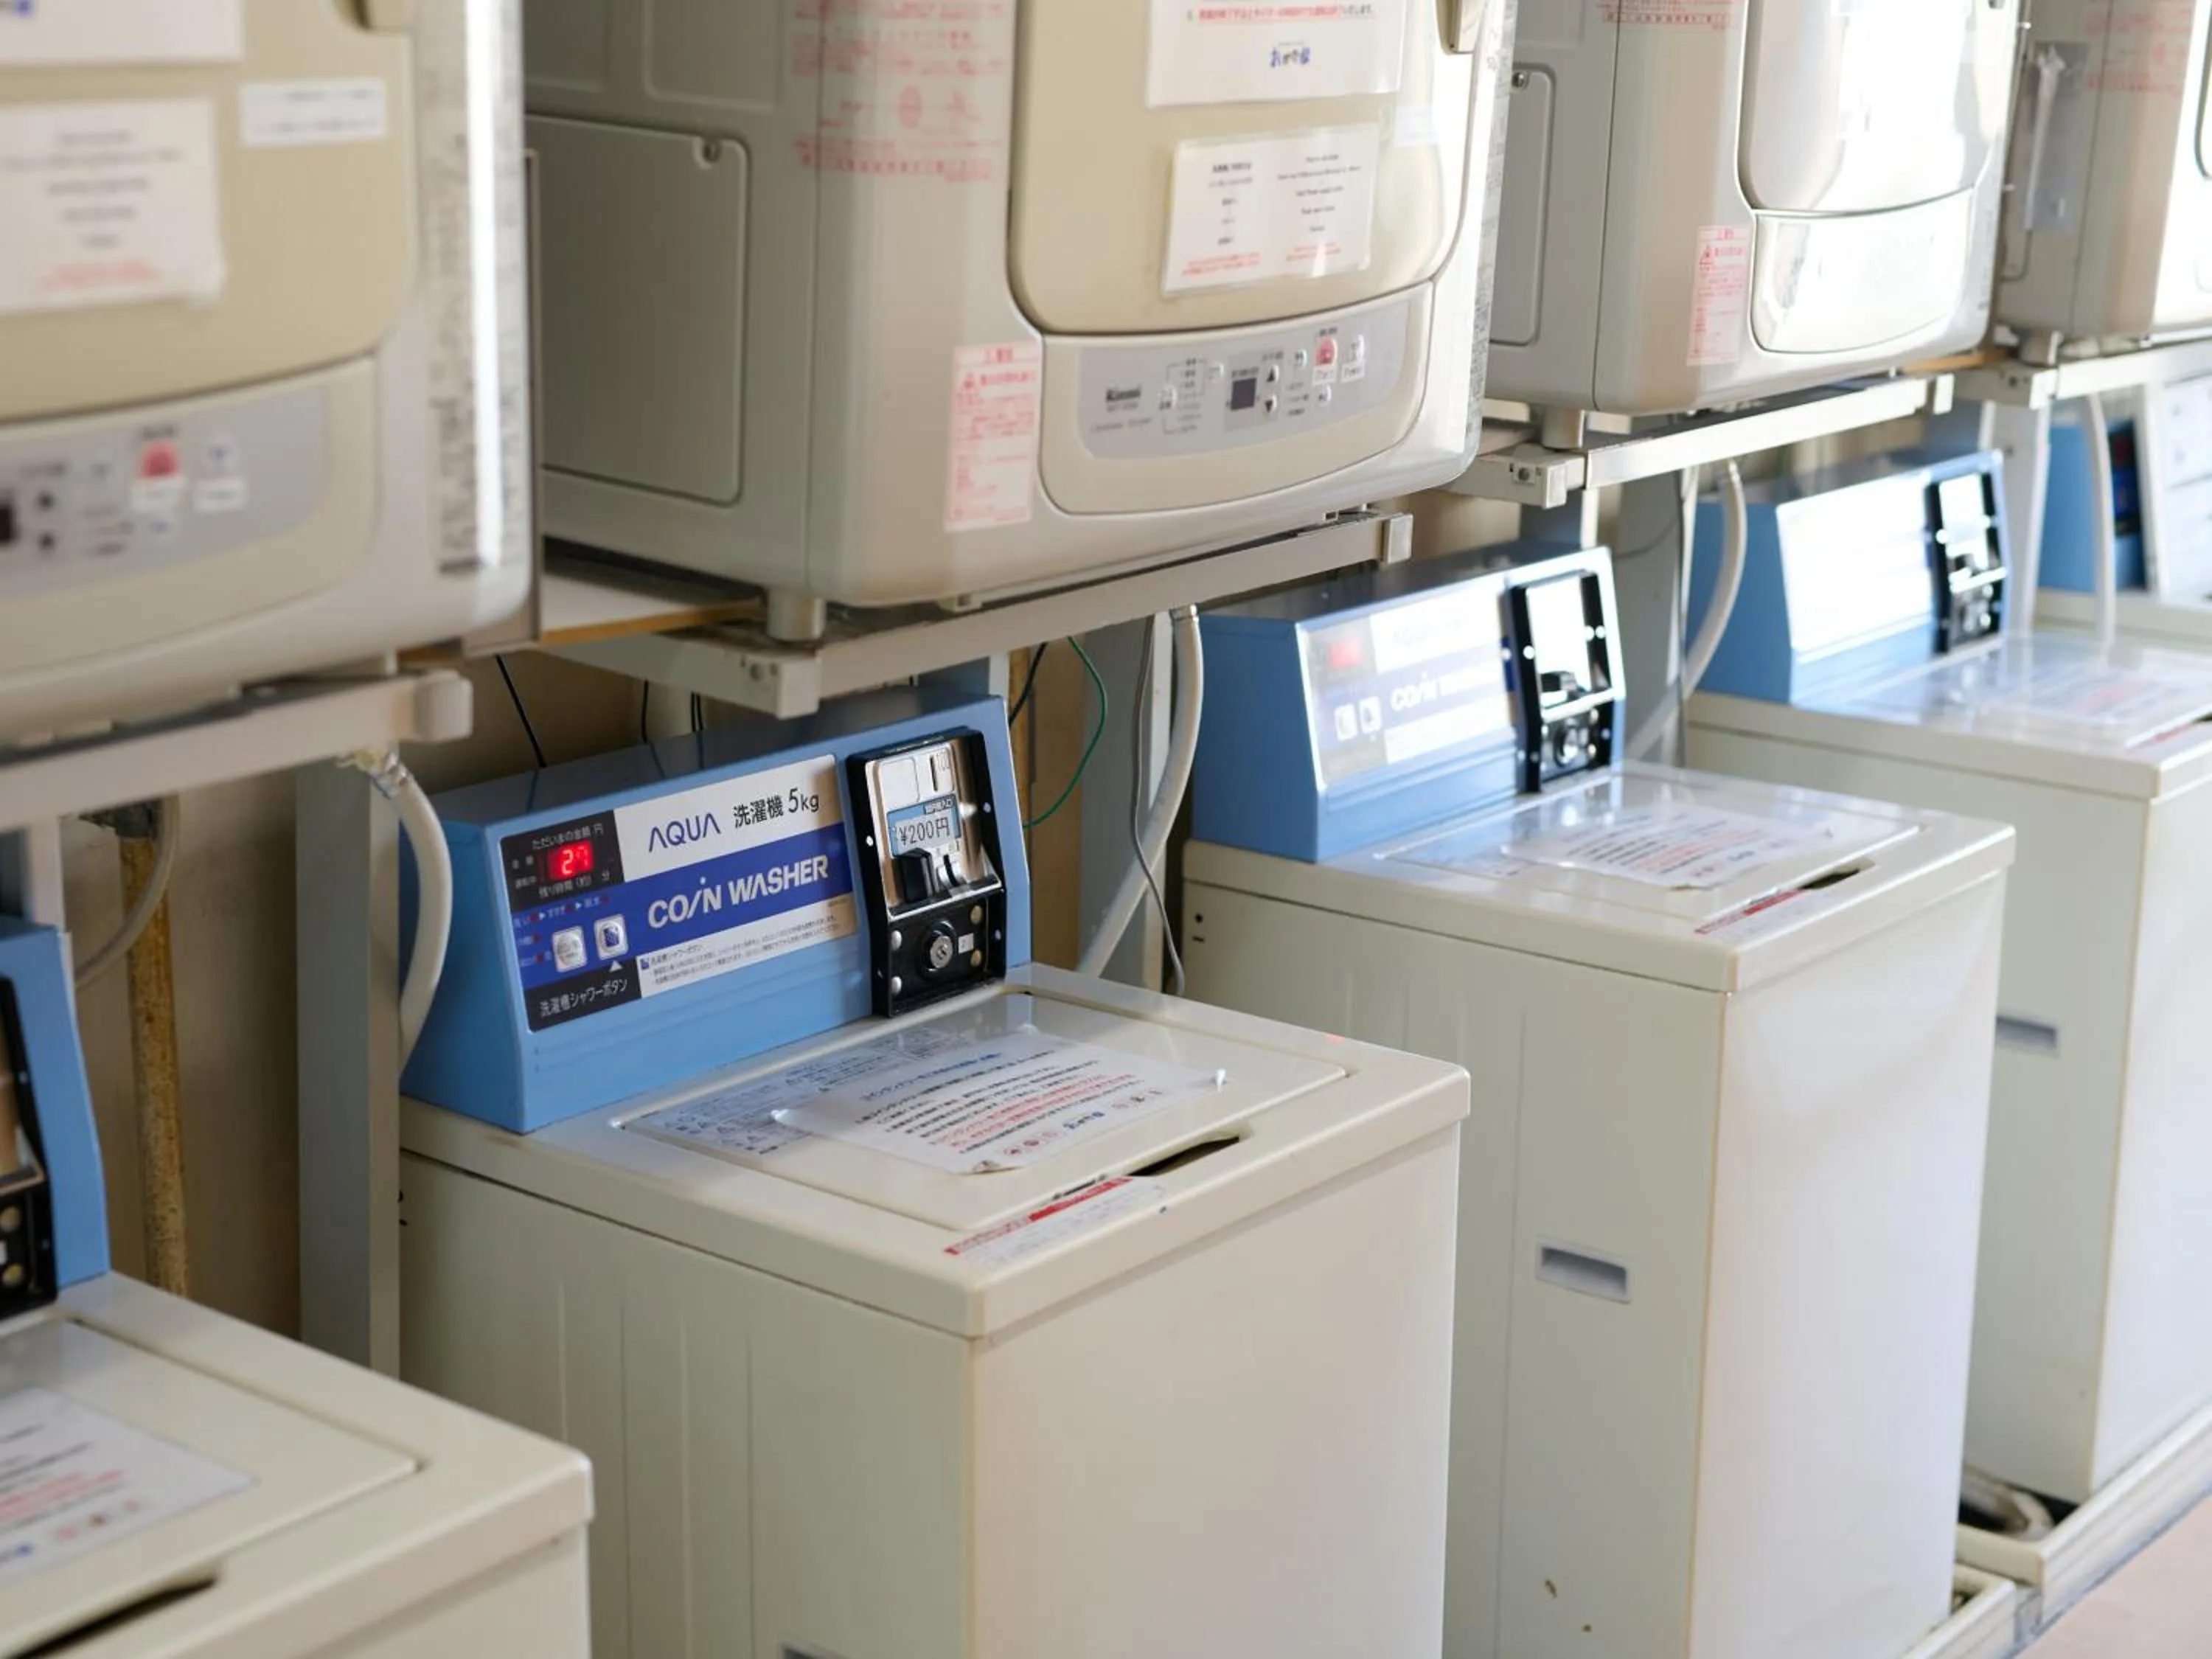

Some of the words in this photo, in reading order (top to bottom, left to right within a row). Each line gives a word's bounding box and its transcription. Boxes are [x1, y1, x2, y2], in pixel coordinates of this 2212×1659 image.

[733, 794, 784, 829] 洗濯機
[787, 787, 820, 813] 5kg
[648, 813, 721, 852] AQUA
[560, 846, 588, 876] 27
[647, 876, 722, 928] COIN
[728, 855, 829, 905] WASHER
